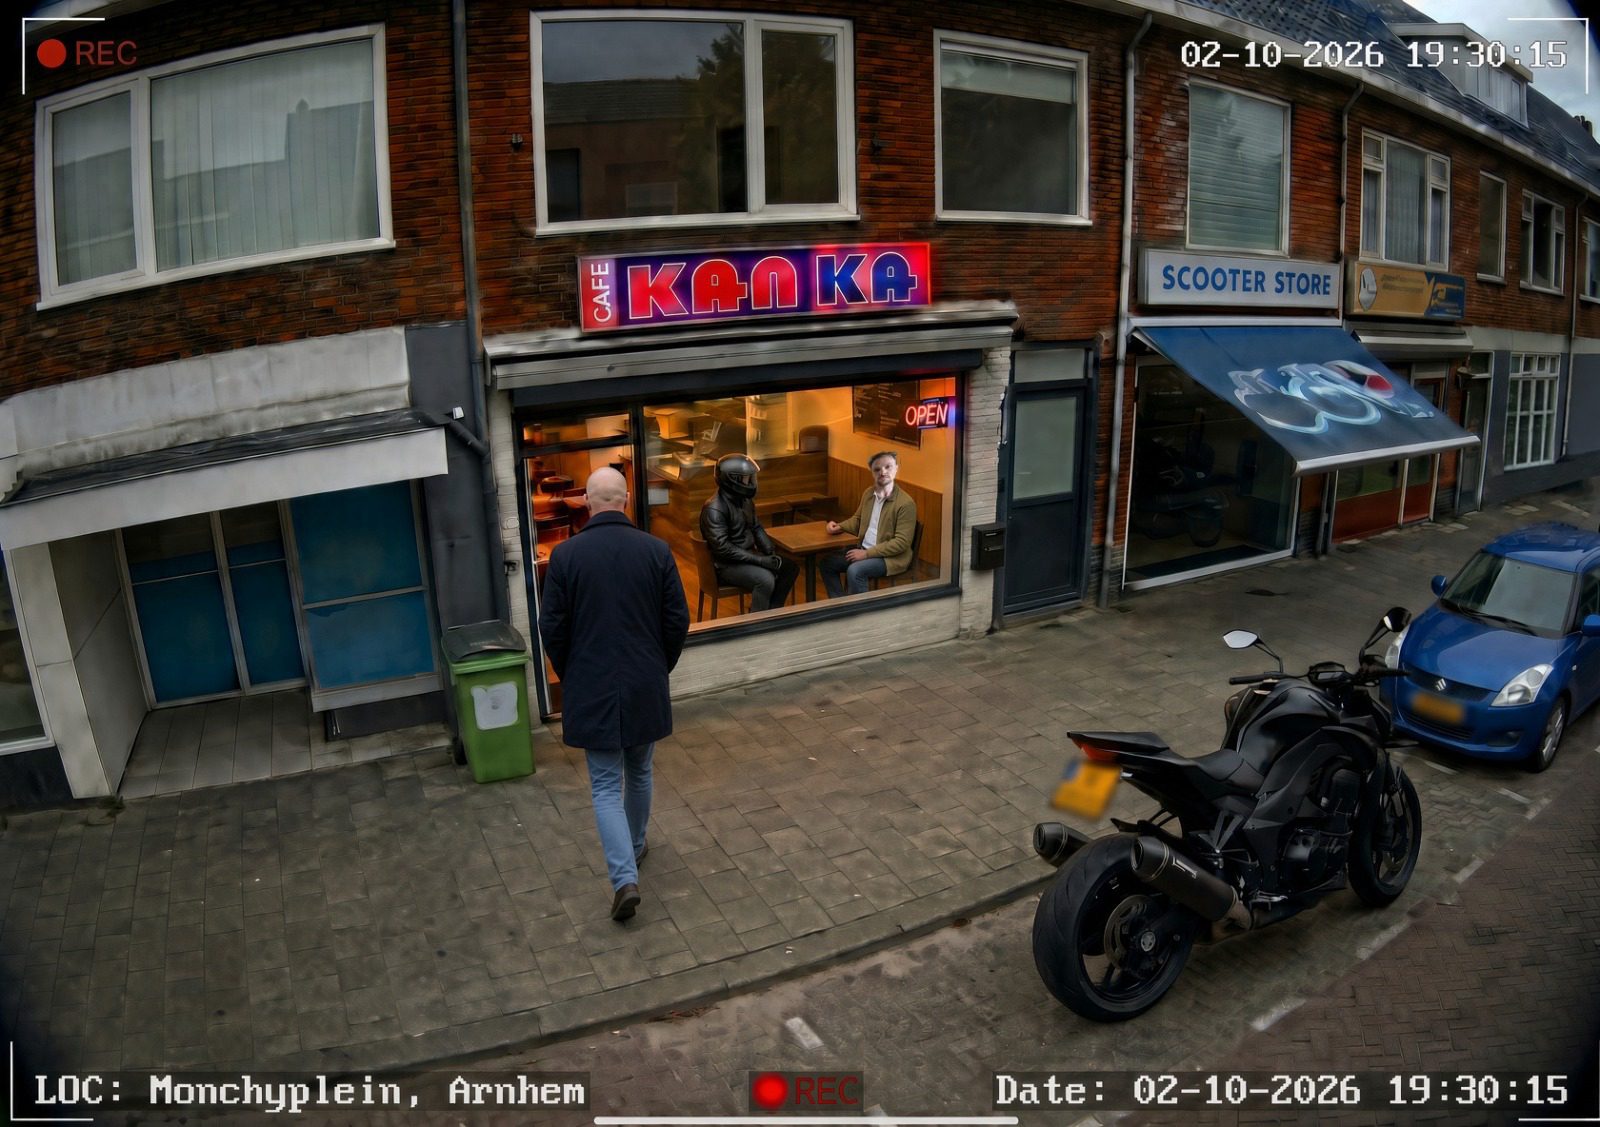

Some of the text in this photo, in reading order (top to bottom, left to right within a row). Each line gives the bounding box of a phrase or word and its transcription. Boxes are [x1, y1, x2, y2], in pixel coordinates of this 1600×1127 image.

[590, 262, 612, 323] CAFE
[1162, 264, 1332, 296] SCOOTER STORE
[905, 403, 949, 426] OPEN
